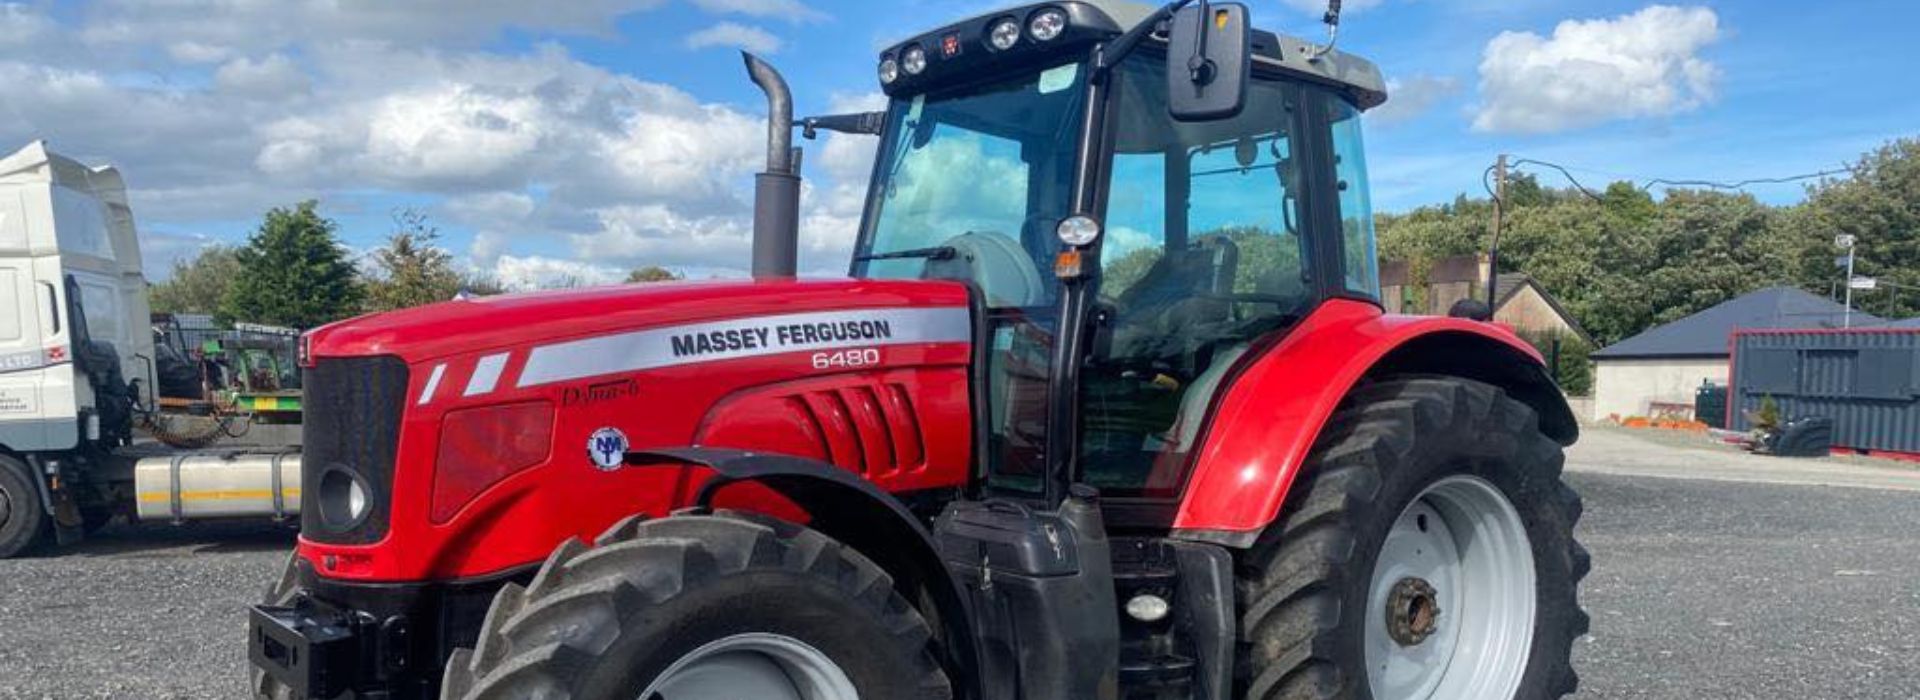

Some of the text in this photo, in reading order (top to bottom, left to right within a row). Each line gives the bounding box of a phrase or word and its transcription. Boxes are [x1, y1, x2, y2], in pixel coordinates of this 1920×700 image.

[671, 319, 891, 357] MASSEY FERGUSON
[812, 348, 880, 369] 6480
